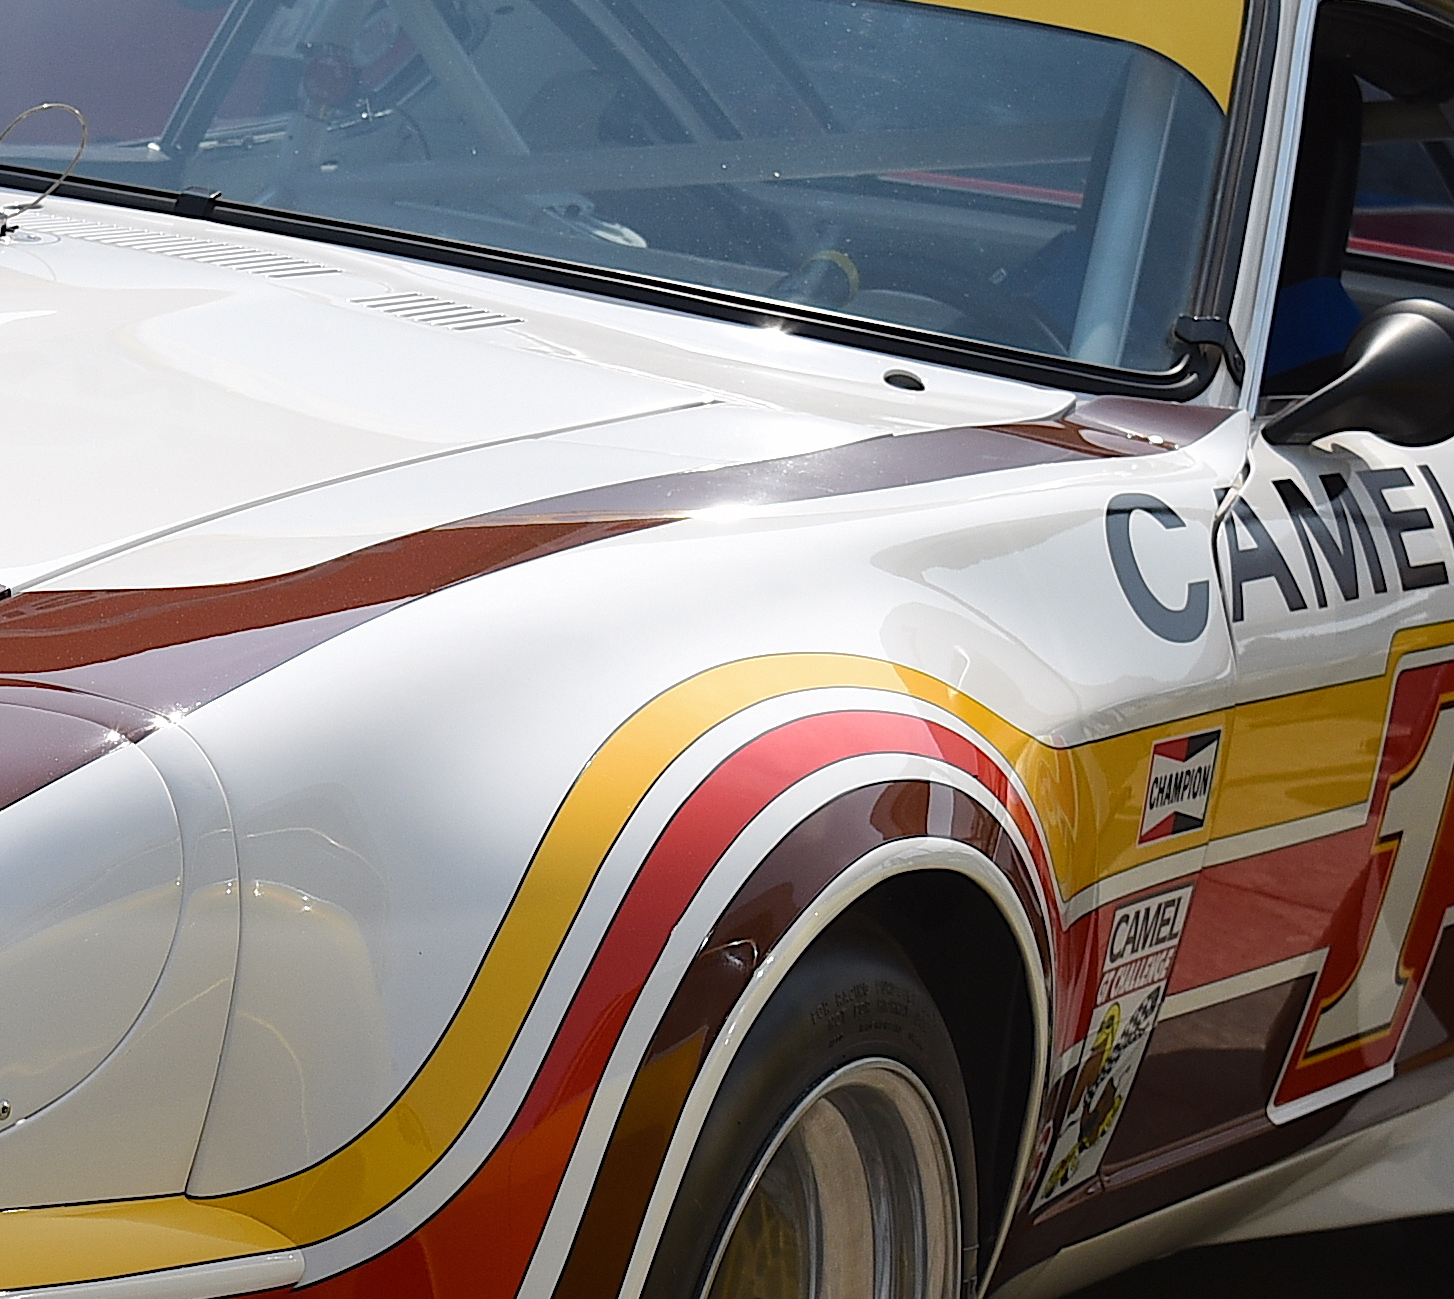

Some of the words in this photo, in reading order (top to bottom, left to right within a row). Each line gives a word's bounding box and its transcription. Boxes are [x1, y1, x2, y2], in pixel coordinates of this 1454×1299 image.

[1149, 764, 1211, 810] CHAMPION
[1108, 896, 1182, 963] CAMEL
[1110, 948, 1176, 1000] CHALLENGE
